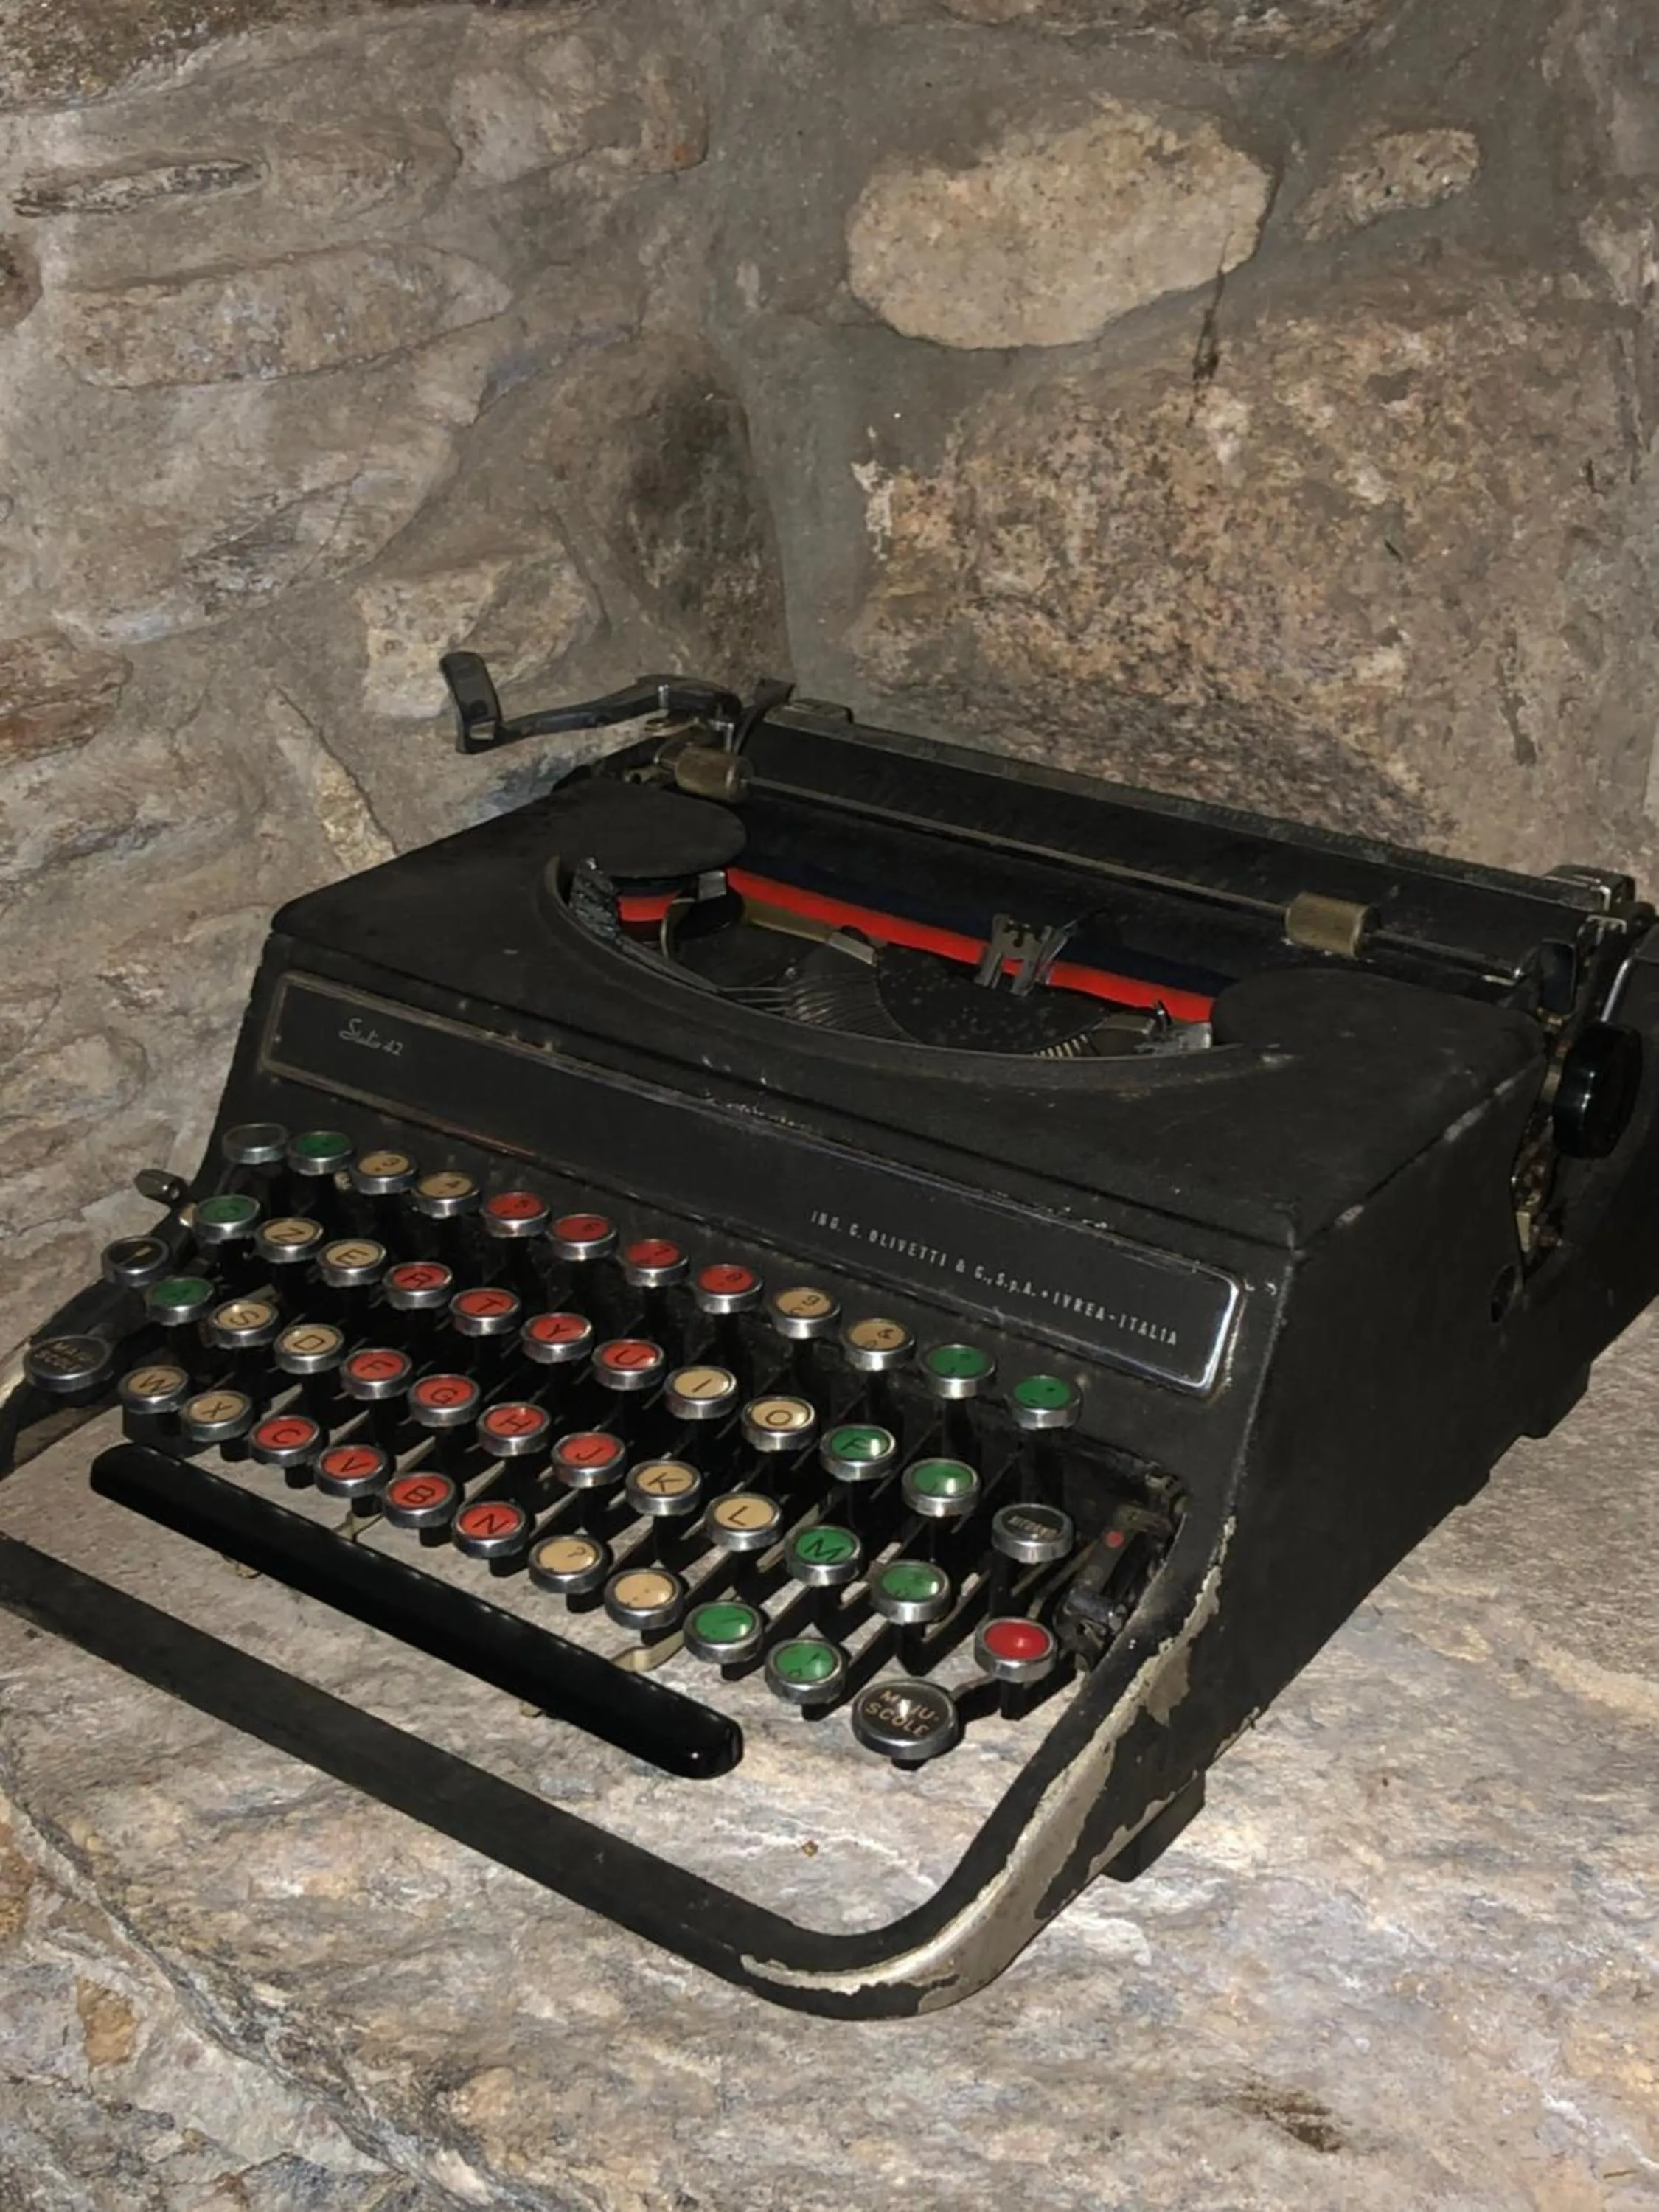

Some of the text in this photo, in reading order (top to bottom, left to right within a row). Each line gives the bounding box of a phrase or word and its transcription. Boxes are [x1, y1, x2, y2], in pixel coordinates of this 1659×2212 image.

[271, 1226, 305, 1243] Z
[869, 1228, 947, 1267] OLIVETTI
[335, 1248, 367, 1265] E
[400, 1270, 433, 1287] R
[476, 1298, 504, 1312] T
[230, 1310, 260, 1326] S
[546, 1324, 573, 1339] Y
[293, 1335, 325, 1351] D
[361, 1357, 394, 1372] F
[613, 1350, 647, 1366] U
[430, 1387, 458, 1404] G
[200, 1402, 233, 1419] X
[498, 1415, 532, 1433] H
[271, 1427, 302, 1444] C
[575, 1446, 604, 1461] J
[340, 1456, 370, 1473] V
[646, 1471, 684, 1492] K
[402, 1484, 437, 1503] B
[471, 1512, 510, 1535] N
[728, 1505, 748, 1526] L
[804, 1538, 846, 1562] M
[866, 1702, 929, 1737] SCOLE
